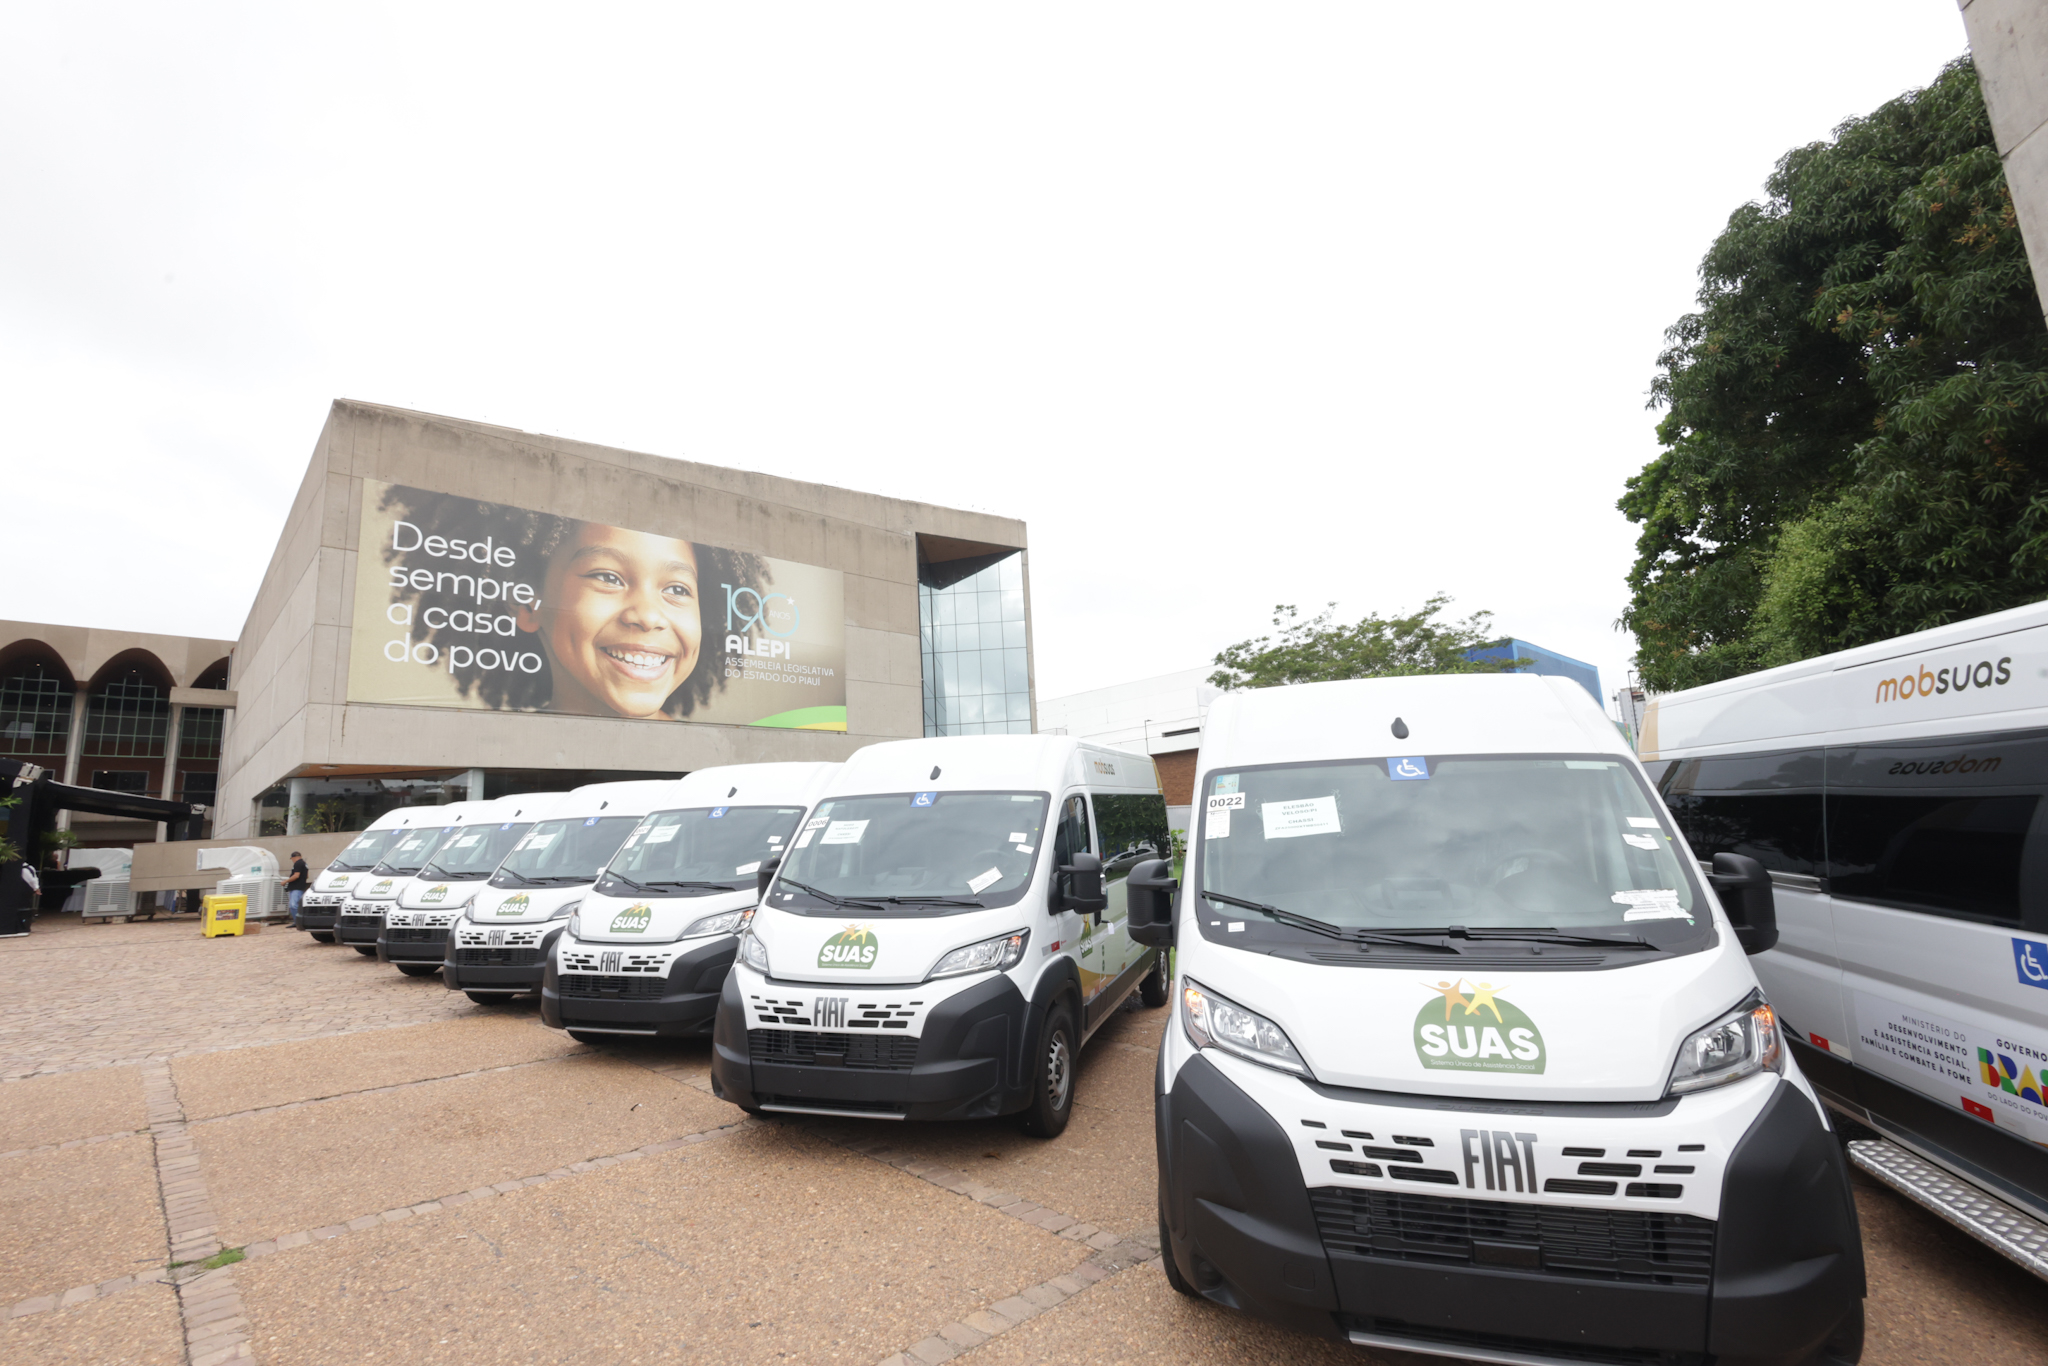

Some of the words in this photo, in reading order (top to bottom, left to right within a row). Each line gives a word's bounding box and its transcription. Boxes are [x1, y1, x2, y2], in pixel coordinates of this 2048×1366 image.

[392, 520, 516, 567] Desde
[388, 565, 542, 611] sempre,
[386, 602, 413, 626] a
[423, 607, 517, 637] casa
[721, 583, 799, 638] 190
[769, 610, 791, 621] ANOS
[383, 631, 439, 665] do
[449, 645, 543, 674] povo
[725, 634, 790, 660] ALEPI
[724, 656, 781, 671] ASSEMBLEIA
[783, 663, 834, 677] LEGISLATIVA
[724, 668, 741, 678] DO
[743, 670, 780, 682] ESTADO
[782, 674, 797, 684] DO
[798, 675, 821, 686] PIAUÍ
[1875, 656, 2012, 704] mobsuas
[1209, 796, 1242, 808] 0022
[1283, 802, 1315, 810] ELESBÃO
[1287, 817, 1314, 825] CHASSI
[422, 892, 446, 901] SUAS
[498, 903, 528, 913] SUAS
[611, 915, 649, 929] SUAS
[487, 929, 507, 946] FIAT
[600, 951, 624, 973] FIAT
[820, 944, 876, 963] SUAS
[813, 996, 850, 1029] FIAT
[1887, 1021, 1968, 1056] DESENVOLVIMENTO
[1901, 1014, 1950, 1037] MINISTÉRIO
[1953, 1031, 1967, 1042] DO
[1420, 1023, 1540, 1061] SUAS
[1873, 1028, 1879, 1037] E
[1880, 1031, 1932, 1057] ASSISTÊNCIA
[1934, 1051, 1970, 1072] SOCIAL,
[1996, 1038, 2047, 1062] GOVERNO
[1455, 1059, 1473, 1067] Único
[1482, 1061, 1516, 1069] Assistência
[1860, 1035, 1890, 1053] FAMÍLIA
[1891, 1047, 1897, 1056] E
[1898, 1050, 1937, 1071] COMBATE
[1947, 1068, 1972, 1085] FOME
[1435, 1104, 1544, 1115] DUCATO
[1987, 1091, 1998, 1101] DO
[1999, 1097, 2018, 1110] LADO
[2020, 1104, 2031, 1115] DO
[1460, 1129, 1538, 1194] FIAT
